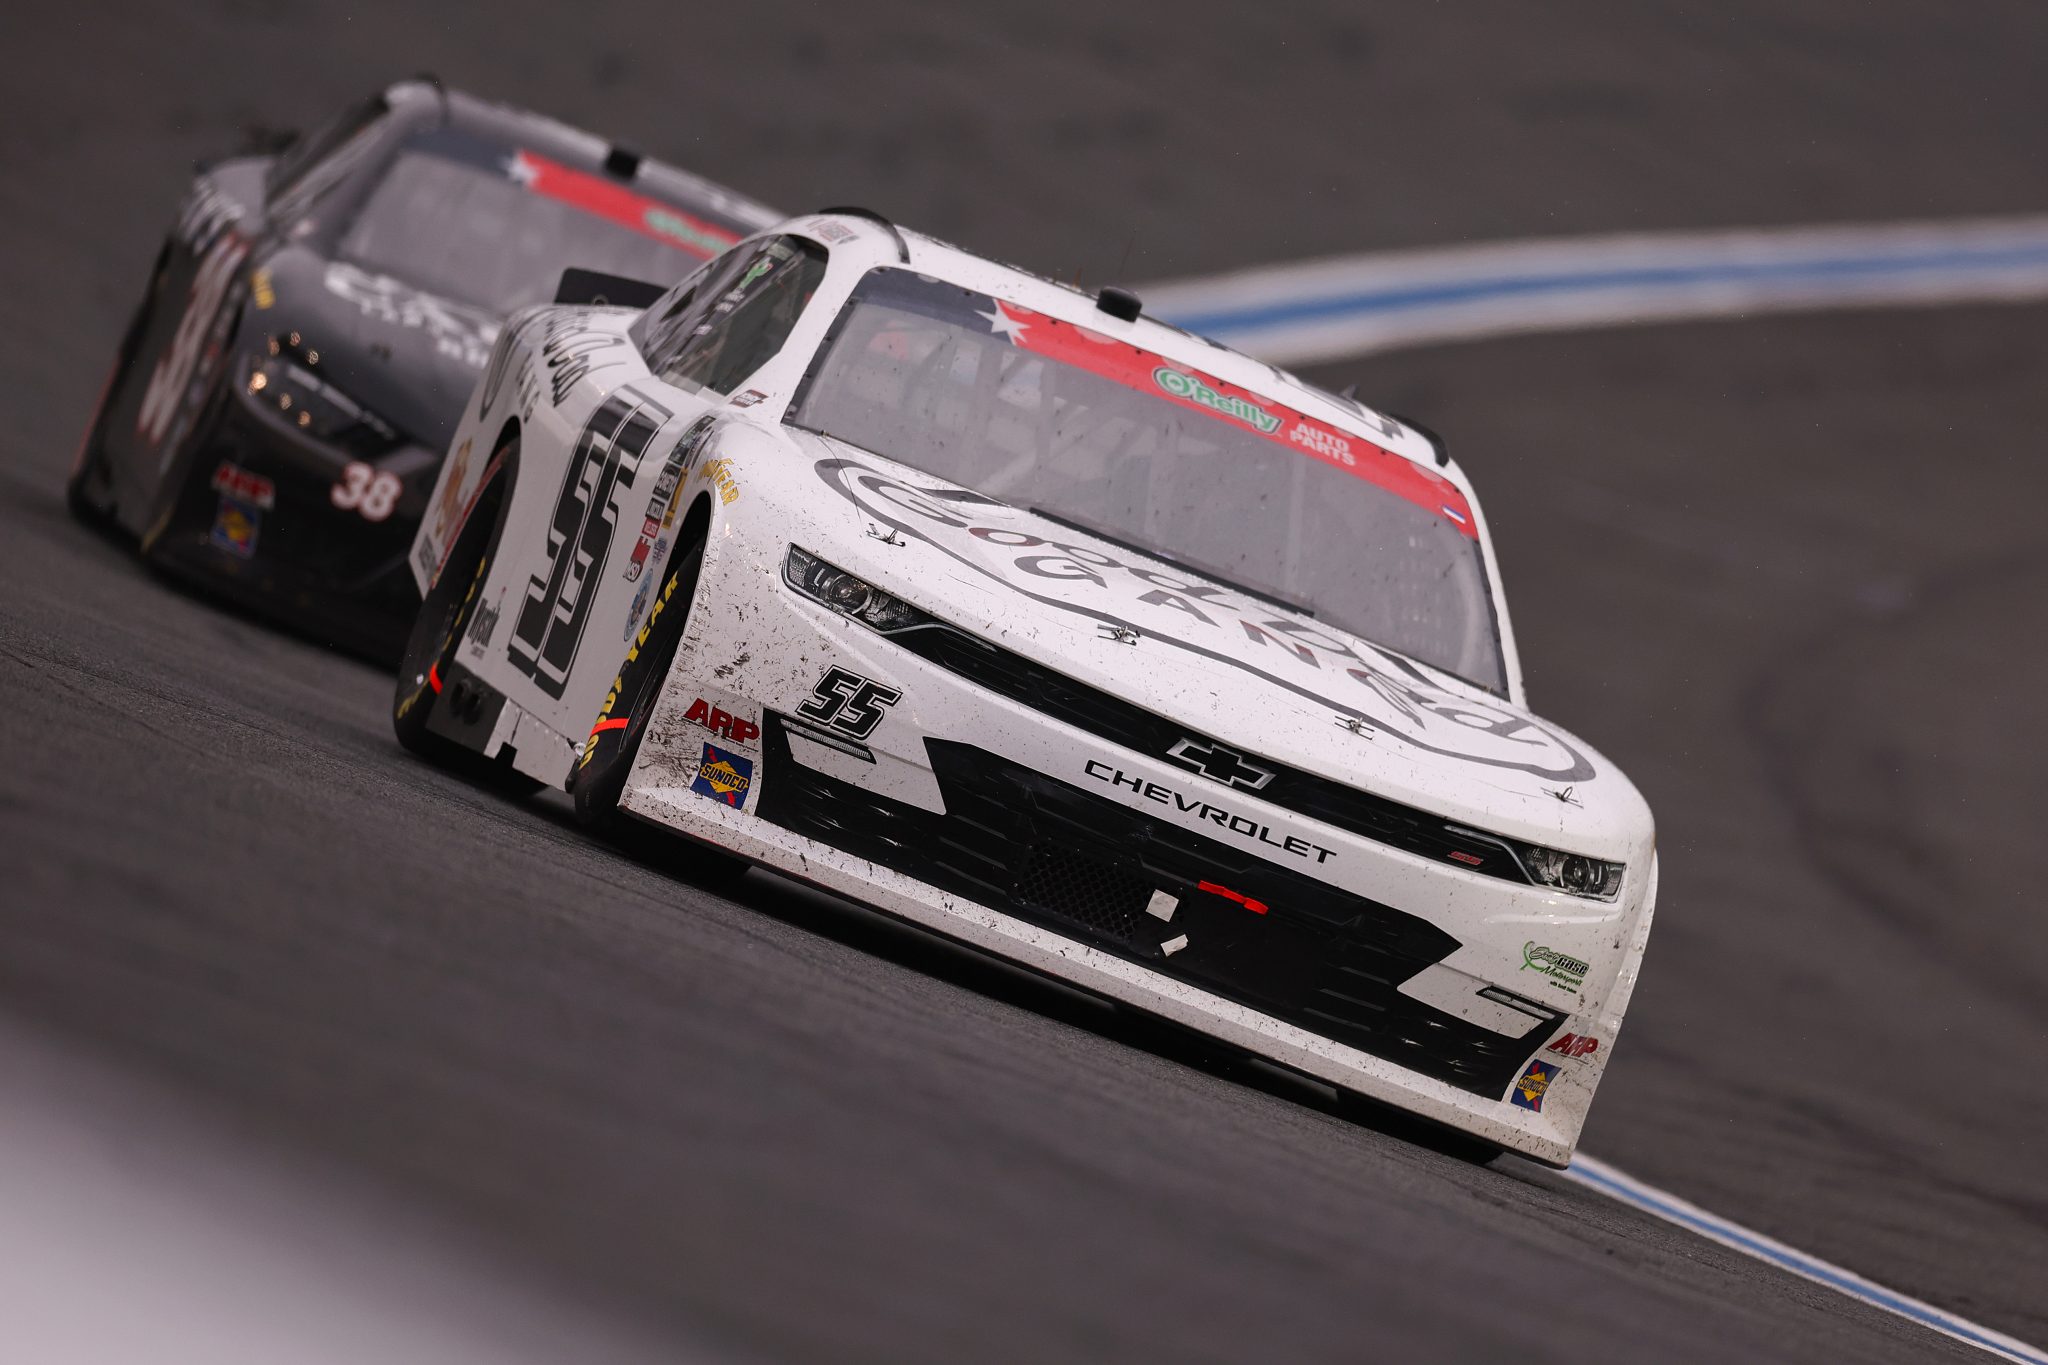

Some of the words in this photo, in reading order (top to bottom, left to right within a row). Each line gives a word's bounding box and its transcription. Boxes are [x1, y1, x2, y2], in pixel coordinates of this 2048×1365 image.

[1154, 367, 1280, 434] O'Reilly
[1289, 429, 1356, 466] PARTS
[1296, 423, 1350, 452] AUTO
[331, 460, 403, 522] 38
[507, 384, 676, 701] 55
[858, 475, 1243, 612] Good
[683, 697, 760, 743] ARP
[795, 664, 903, 741] 55
[700, 763, 747, 791] SUNOCO
[1084, 759, 1337, 864] CHEVROLET
[1547, 1031, 1599, 1058] ARP
[1518, 1076, 1548, 1096] SUNOCO
